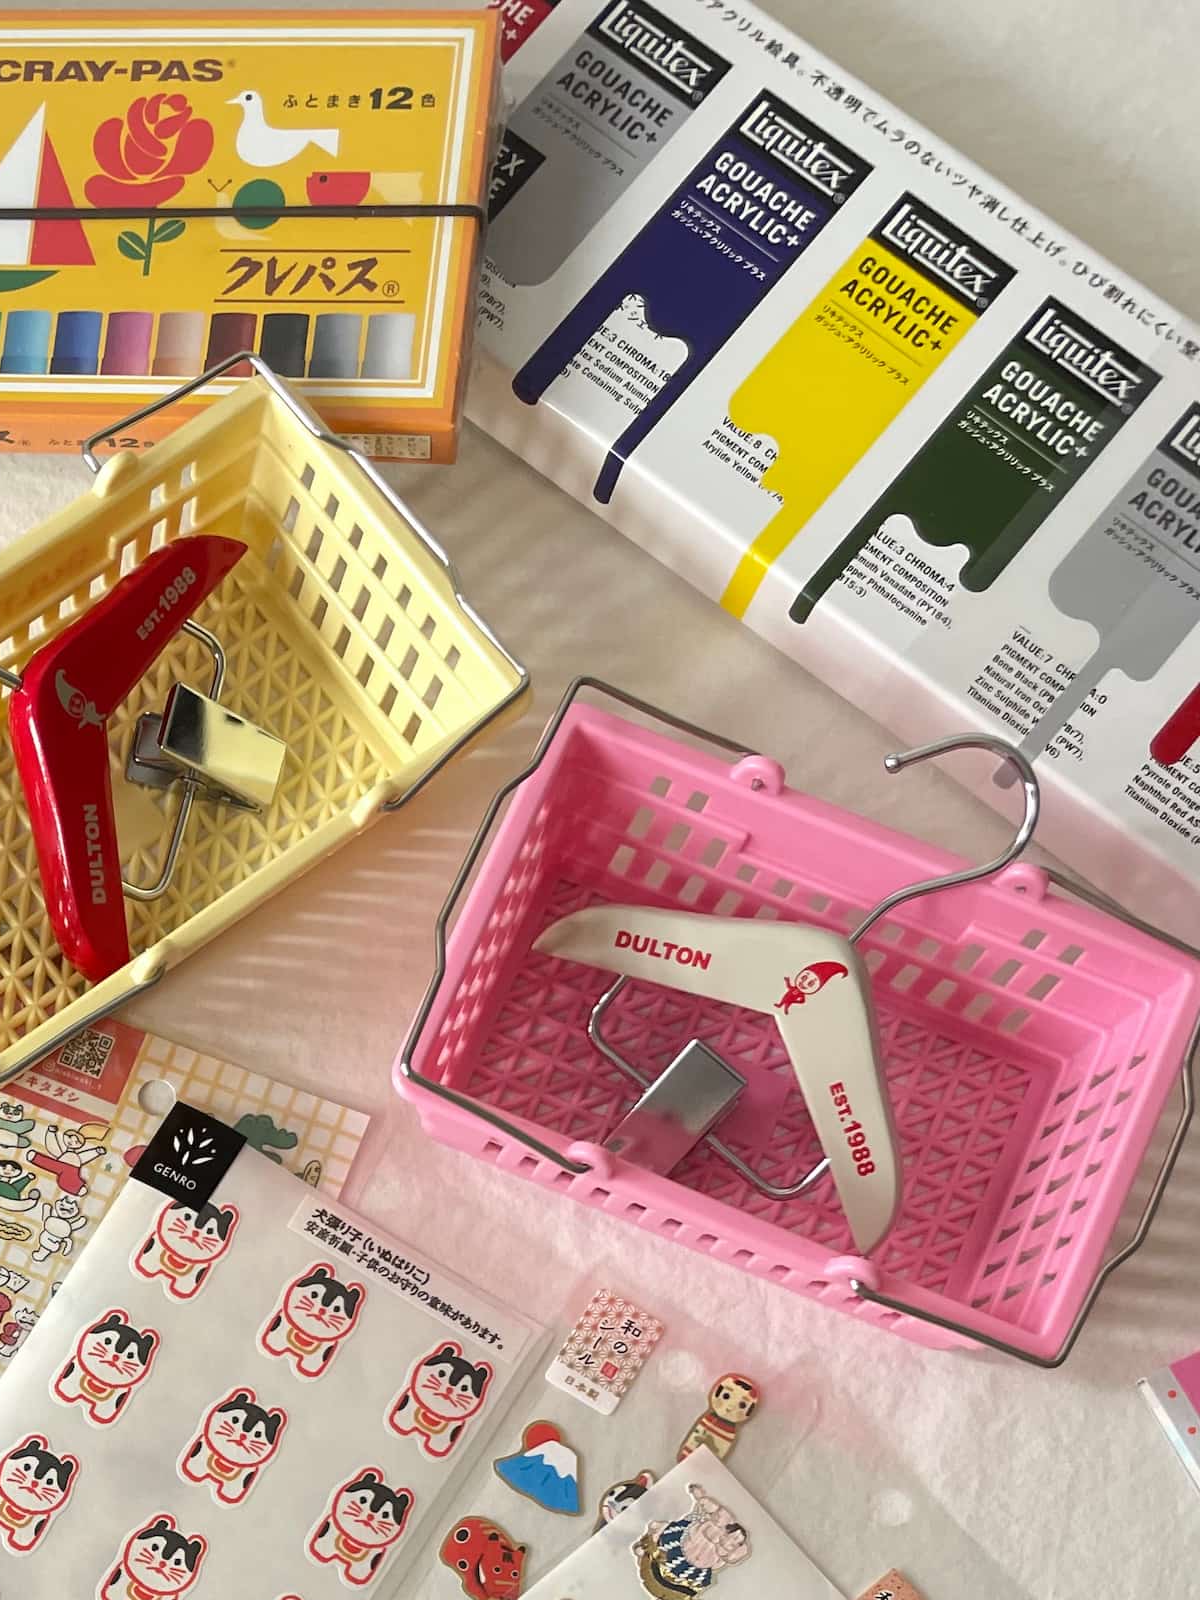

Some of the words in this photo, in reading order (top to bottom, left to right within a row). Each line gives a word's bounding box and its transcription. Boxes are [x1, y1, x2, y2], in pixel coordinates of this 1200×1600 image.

[599, 0, 714, 95] Liquitex
[575, 50, 673, 128] GOUACHE
[739, 101, 855, 196] Liquitex
[714, 152, 816, 232] GOUACHE
[881, 203, 998, 301] Liquitex
[858, 256, 958, 335] GOUACHE
[1025, 309, 1142, 407] Liquitex
[1001, 361, 1104, 442] GOUACHE
[891, 564, 949, 608] COMPOSITION
[80, 803, 106, 905] DULTON
[614, 930, 712, 970] DULTON
[153, 1162, 197, 1191] GENRO
